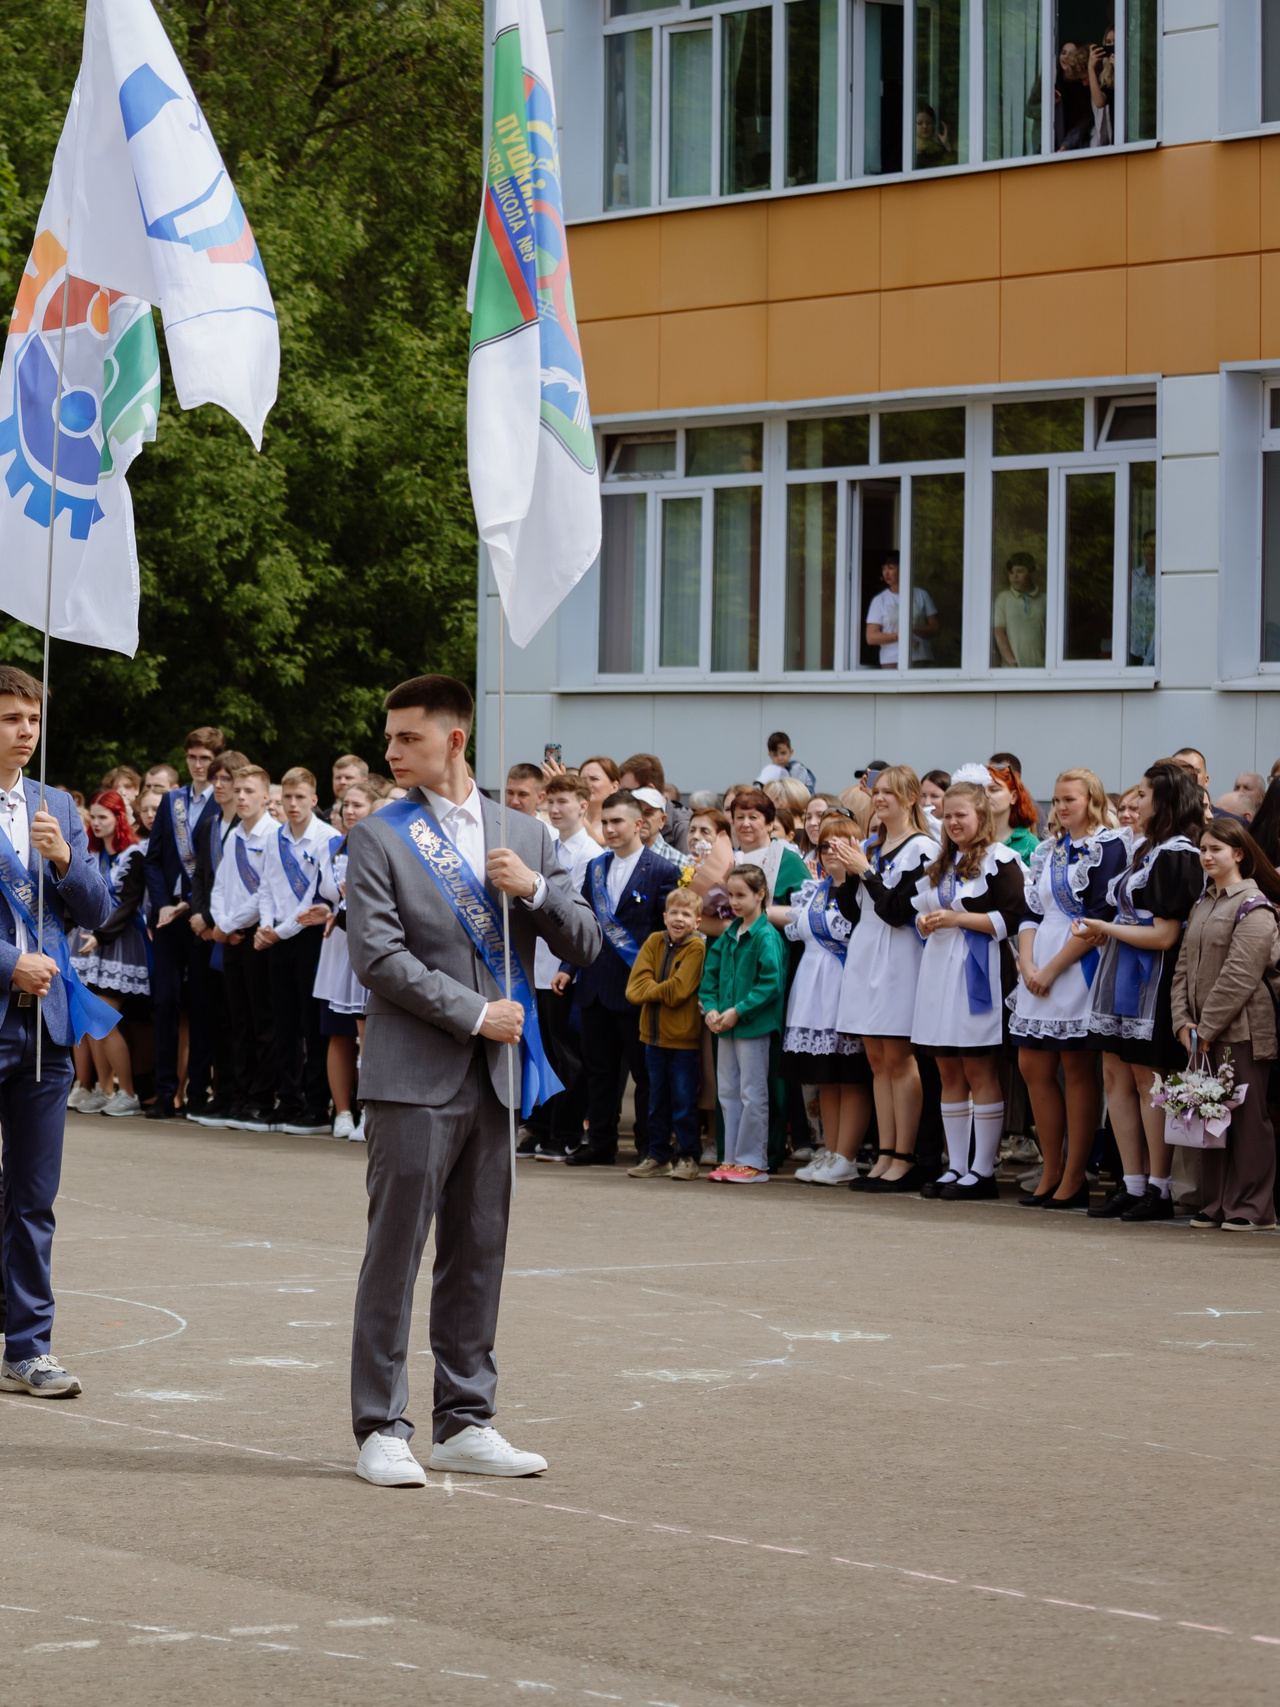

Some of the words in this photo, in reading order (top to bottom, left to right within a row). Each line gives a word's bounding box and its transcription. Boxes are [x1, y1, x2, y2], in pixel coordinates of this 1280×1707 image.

[493, 174, 527, 234] ШКОЛА
[516, 234, 536, 263] №8
[495, 112, 535, 229] ПУШКИ
[428, 848, 505, 954] Выпускник
